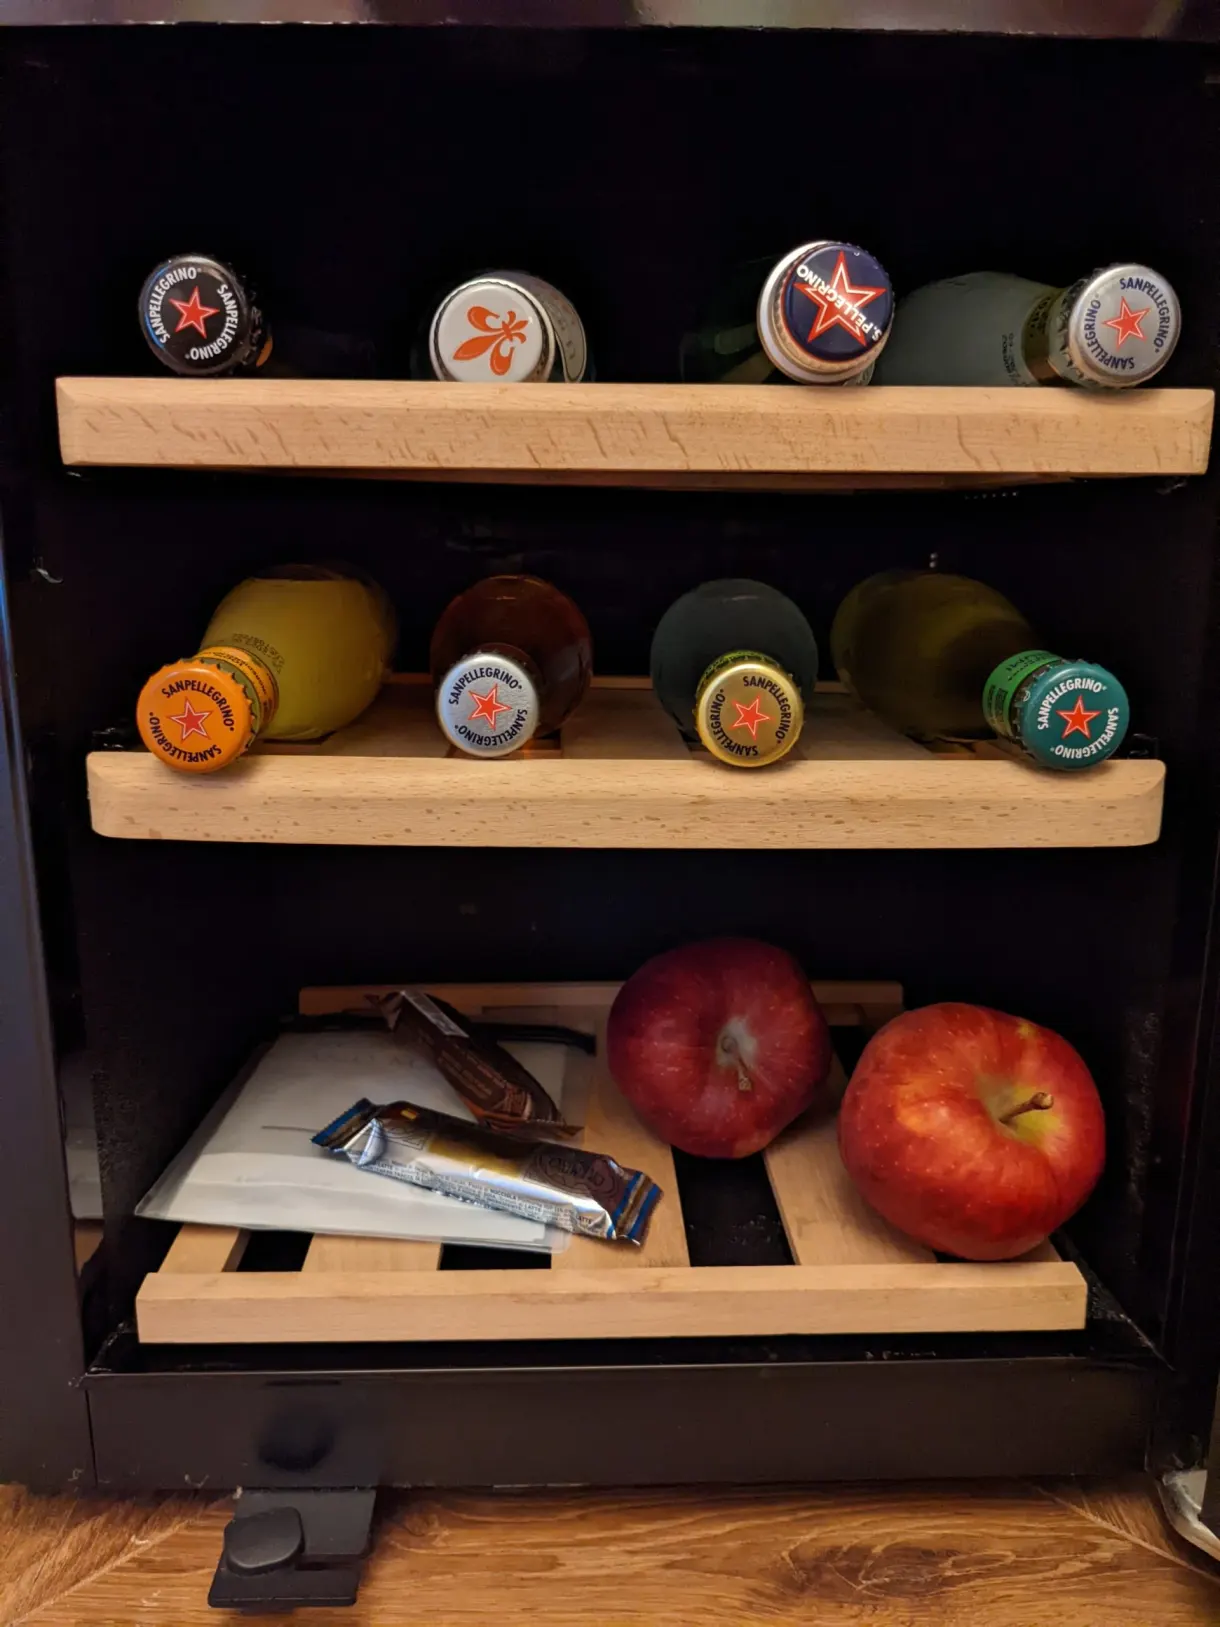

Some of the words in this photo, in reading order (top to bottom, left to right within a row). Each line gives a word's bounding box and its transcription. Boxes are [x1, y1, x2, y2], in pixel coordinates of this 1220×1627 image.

[149, 267, 197, 343] SANPELLEGRINO
[190, 284, 238, 360] SANPELLEGRINO
[162, 680, 235, 727] SANPELLEGRINO
[449, 667, 519, 706] SANPELLEGRINO
[743, 676, 792, 740] SANPELLEGRINO
[1037, 678, 1102, 730] SANPELLEGRINO
[149, 716, 222, 763] SANPELLEGRINO
[458, 709, 528, 746] SANPELLEGRINO
[710, 693, 759, 756] SANPELLEGRINO
[1055, 707, 1119, 759] SANPELLEGRINO
